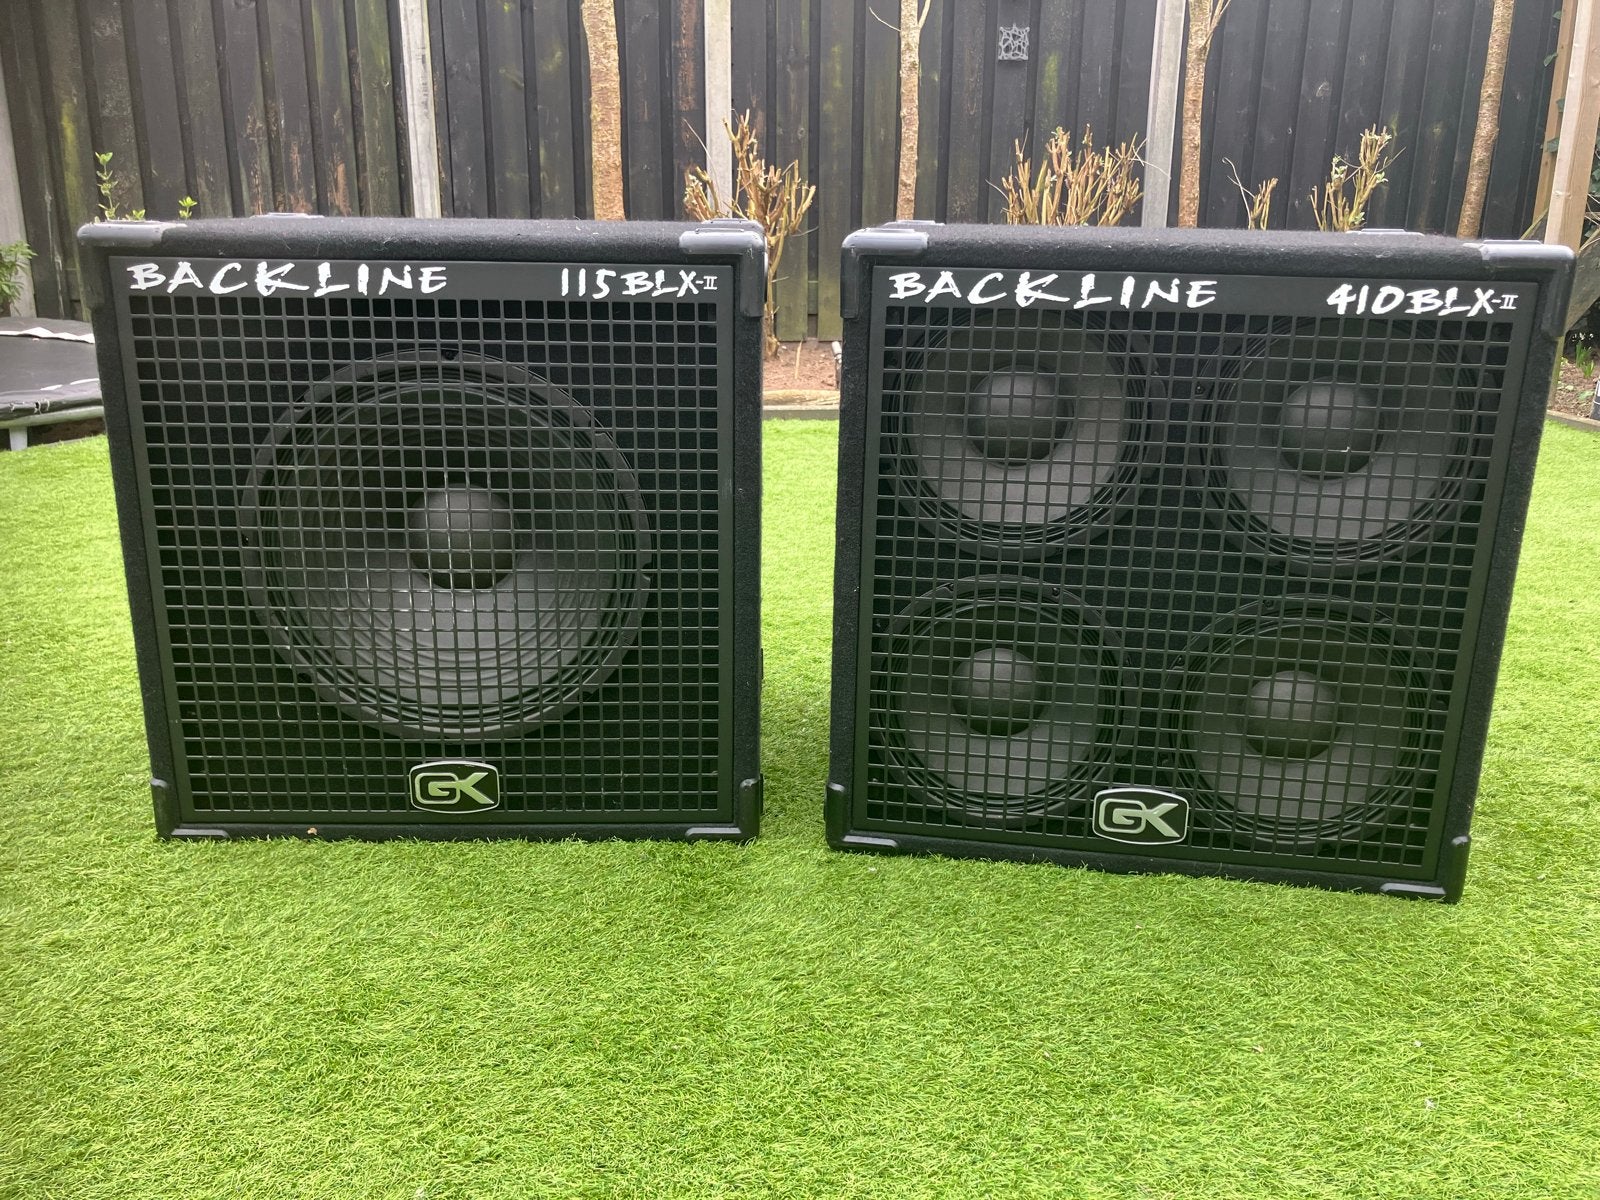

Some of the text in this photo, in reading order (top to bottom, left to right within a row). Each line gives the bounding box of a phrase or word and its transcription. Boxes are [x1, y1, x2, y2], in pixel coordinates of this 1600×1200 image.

[127, 260, 448, 298] BACKLINE
[888, 271, 1218, 309] BACKLINE
[414, 772, 495, 805] GK
[1098, 798, 1181, 838] GK
